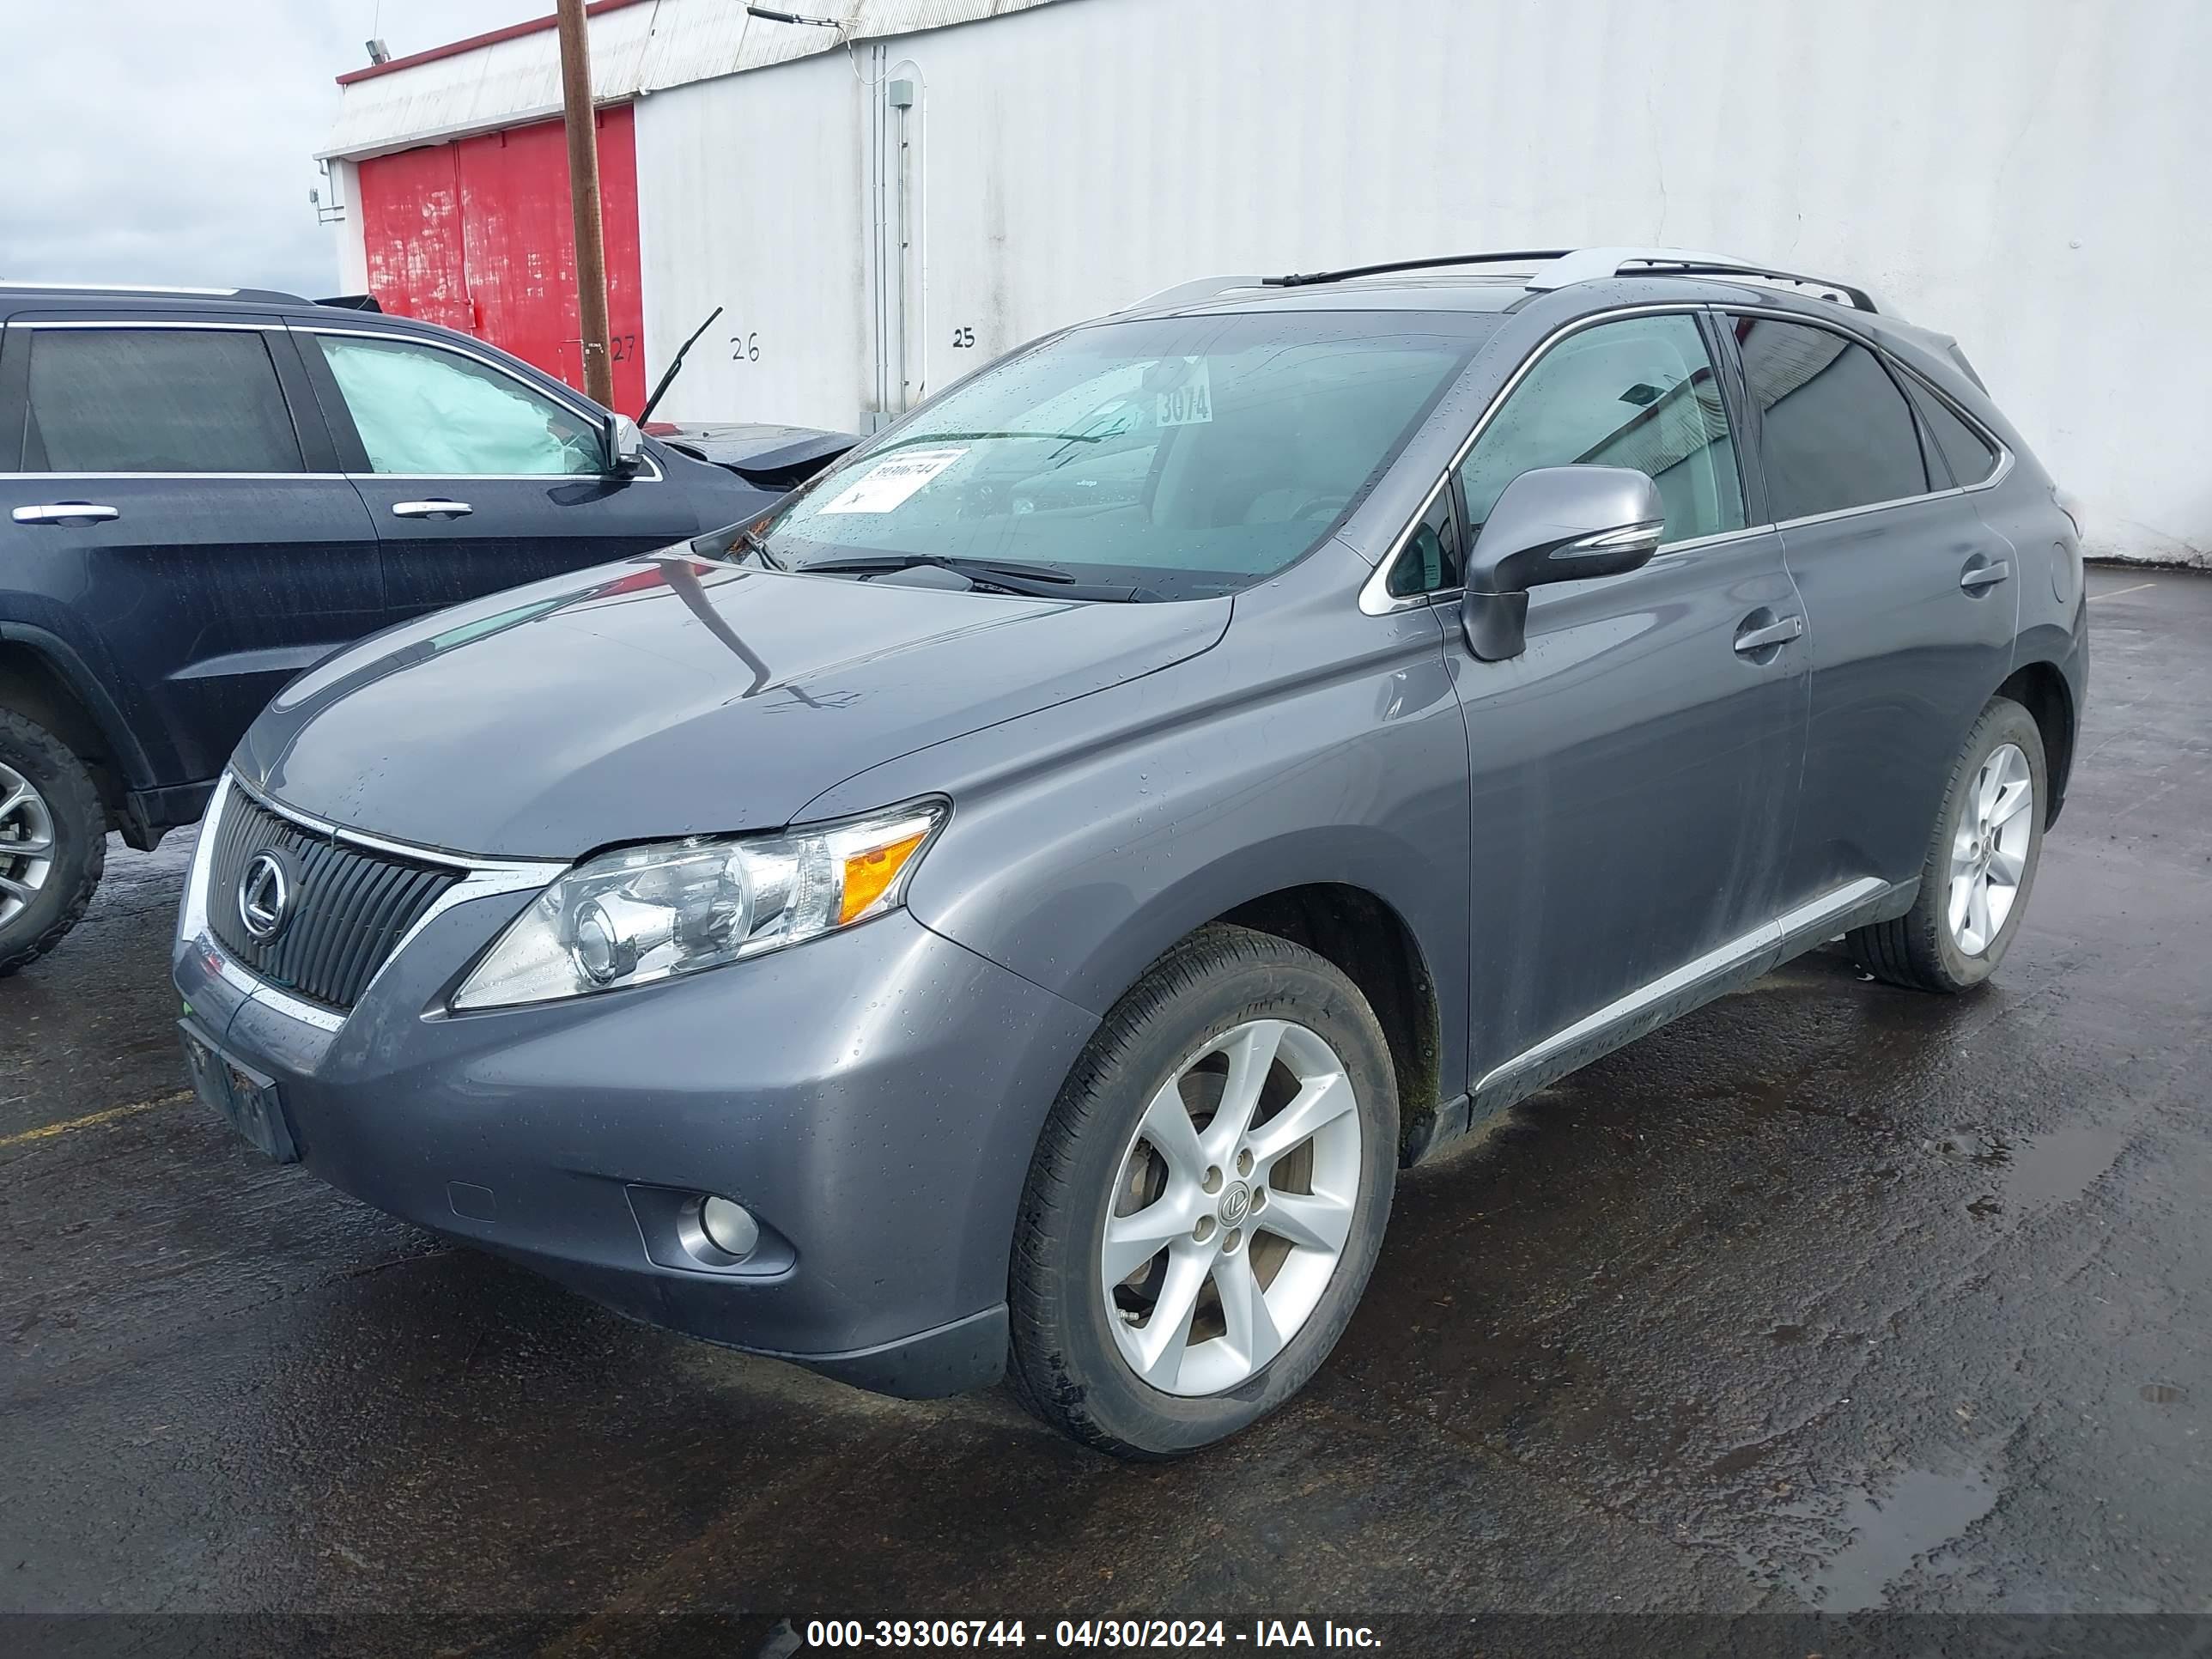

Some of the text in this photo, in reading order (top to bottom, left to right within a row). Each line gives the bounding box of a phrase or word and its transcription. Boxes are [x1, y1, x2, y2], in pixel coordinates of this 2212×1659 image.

[611, 336, 635, 362] 27
[730, 332, 760, 362] 26
[952, 327, 975, 349] 25
[1160, 385, 1209, 423] 3074
